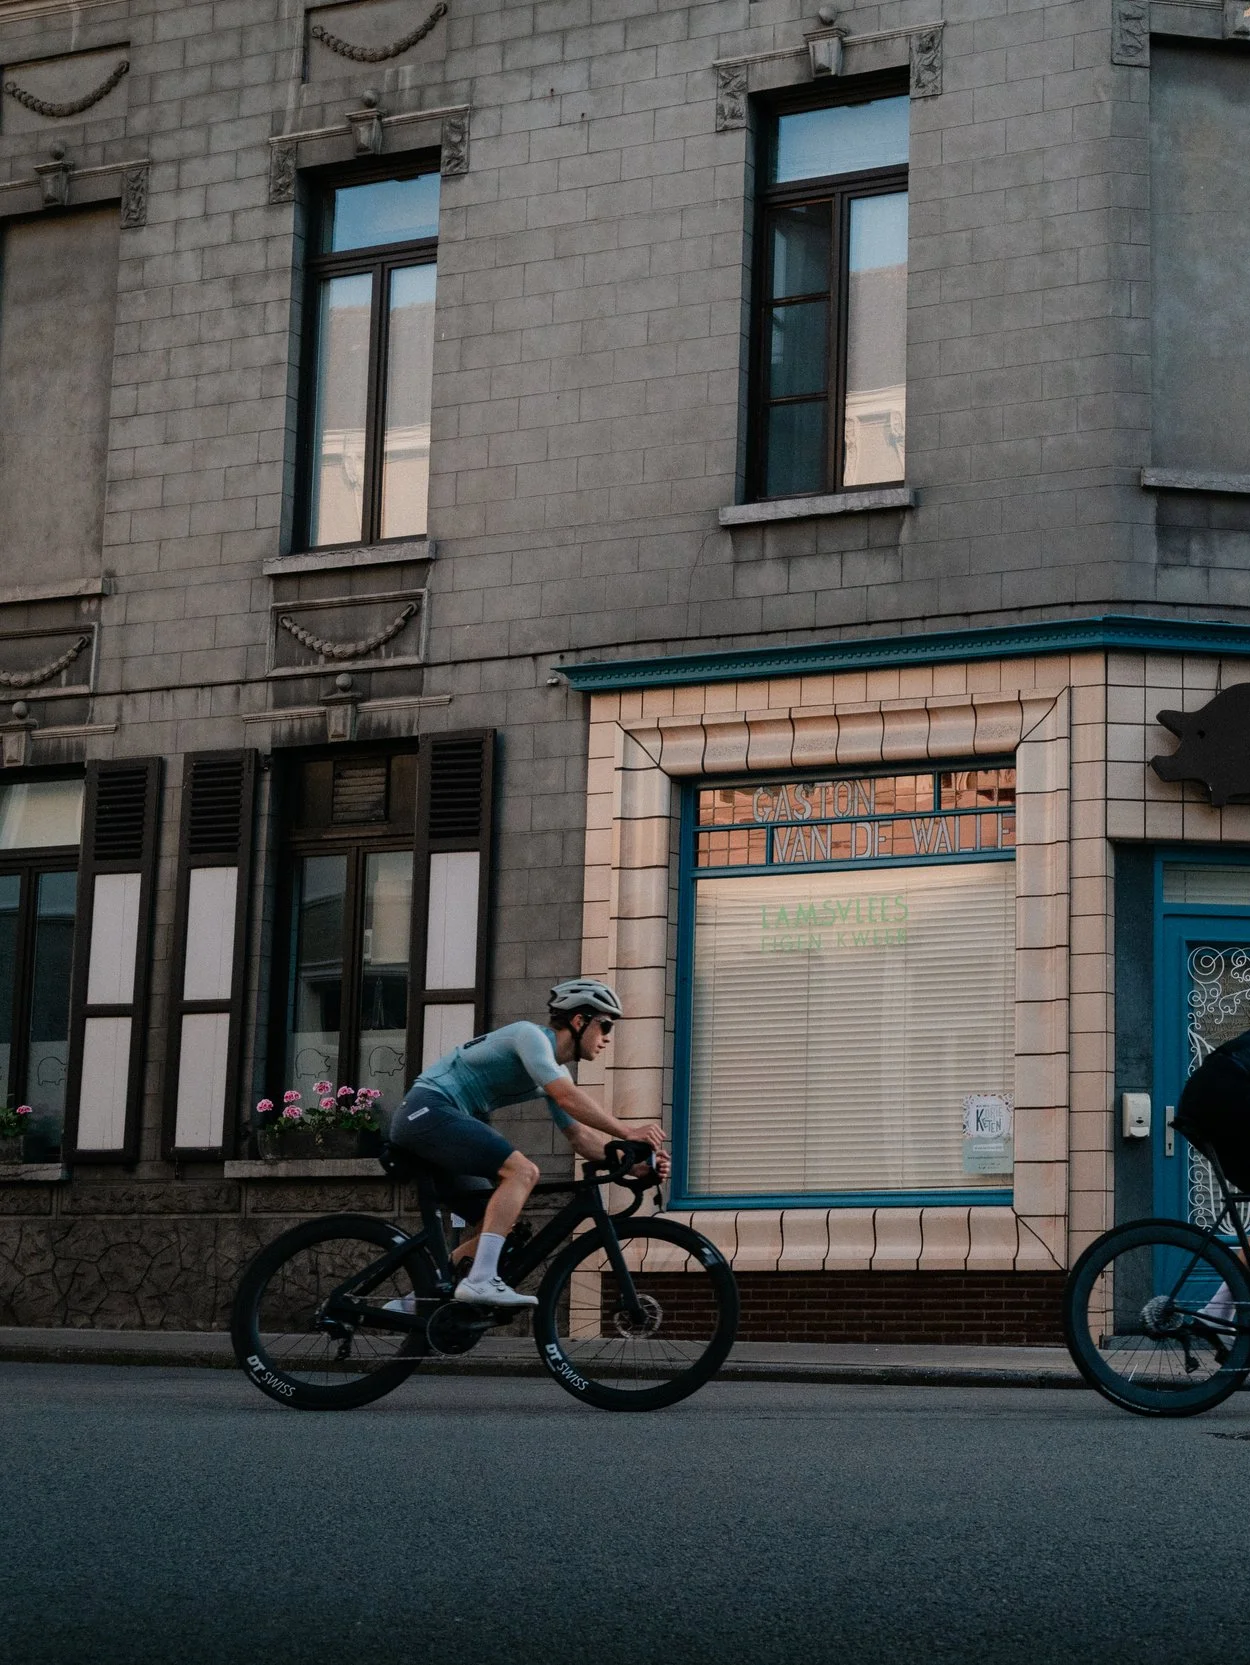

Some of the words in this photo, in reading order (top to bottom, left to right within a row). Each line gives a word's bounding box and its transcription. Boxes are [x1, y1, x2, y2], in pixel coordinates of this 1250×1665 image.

[752, 779, 876, 822] GASTON
[773, 823, 832, 862] VAN
[850, 819, 892, 858] DE
[910, 812, 1016, 854] WALLE
[761, 932, 822, 953] EIGEN
[246, 1354, 267, 1372] DT
[261, 1371, 297, 1397] SWISS
[545, 1343, 563, 1361] DT
[556, 1362, 590, 1391] SWISS
